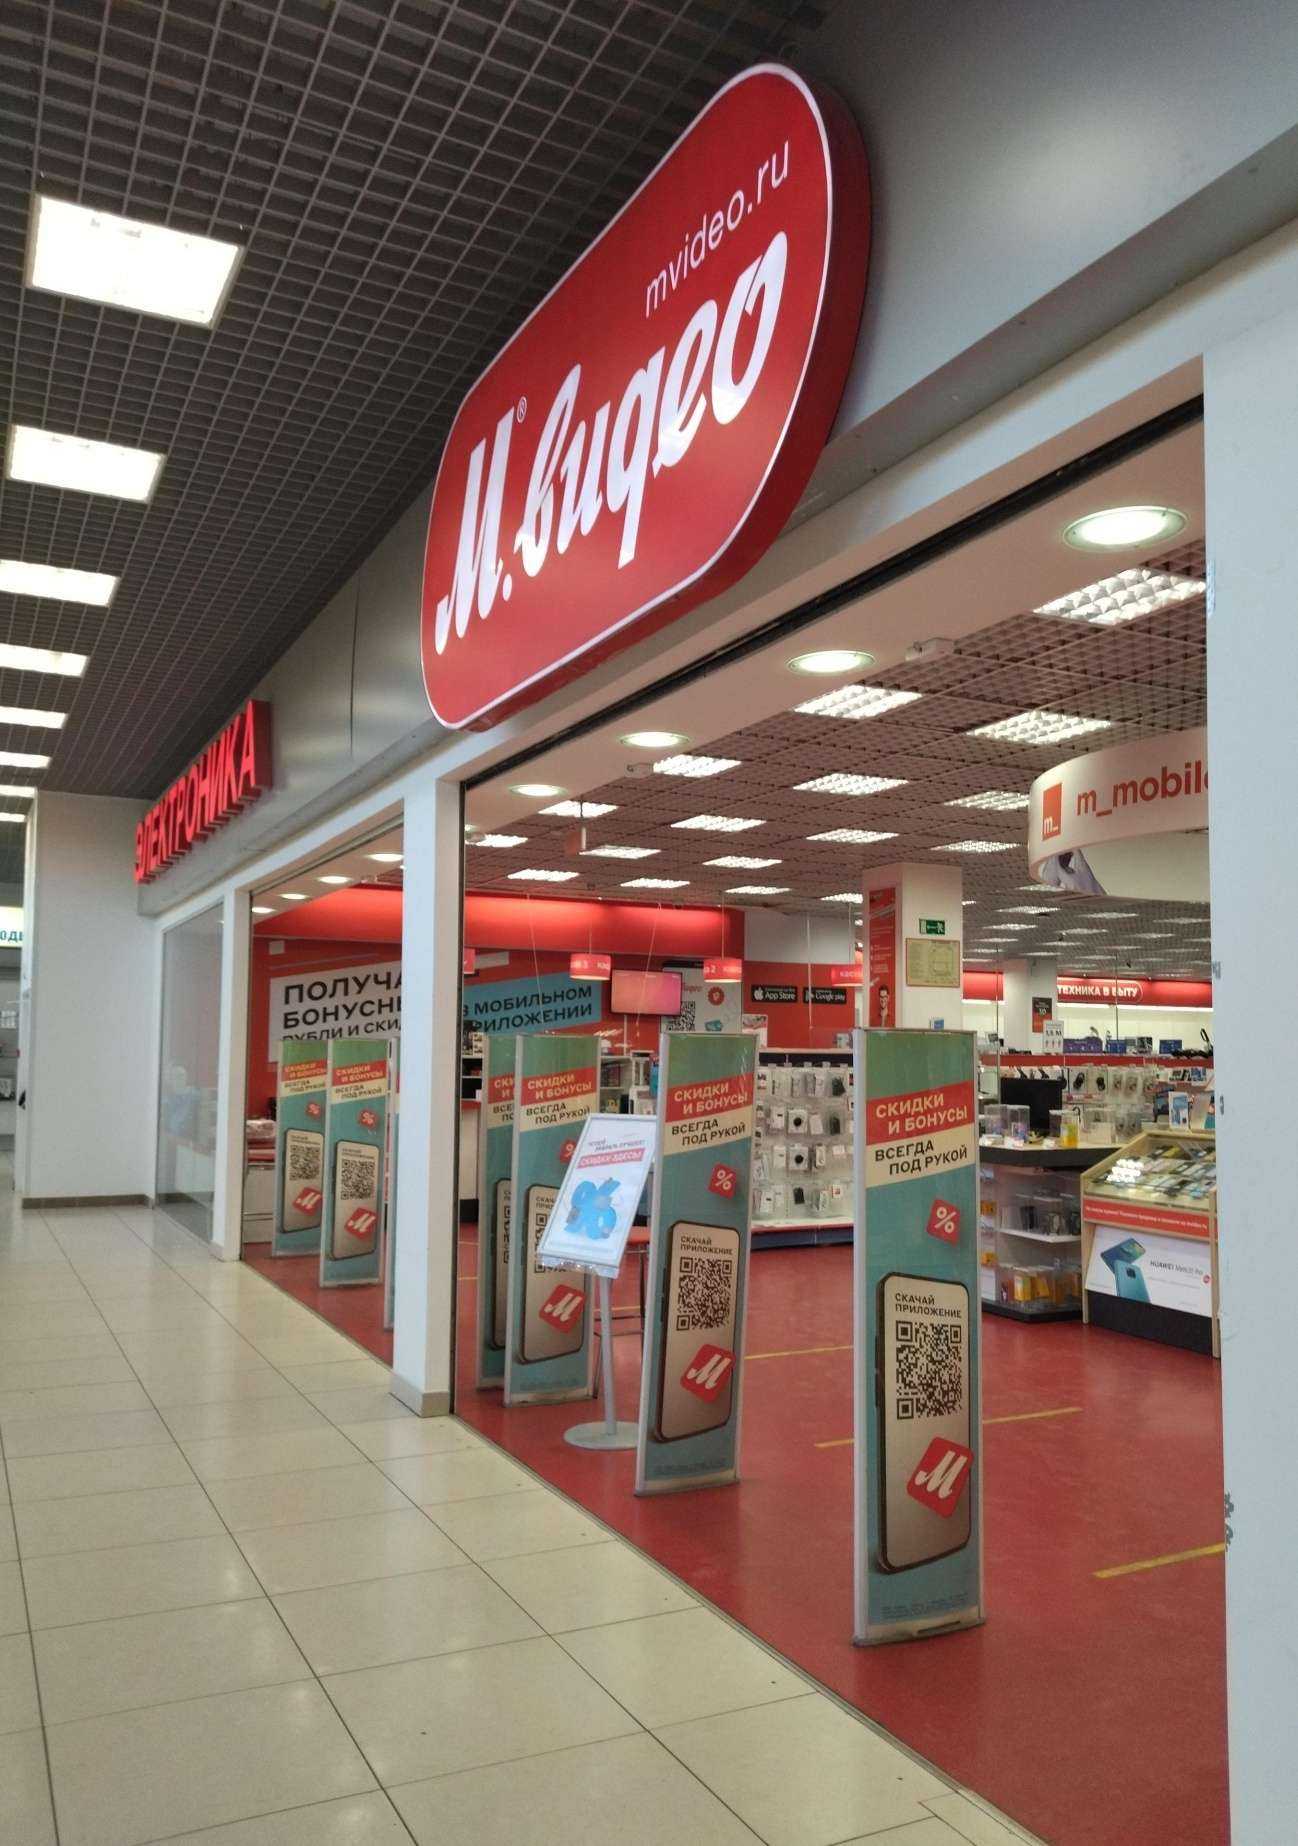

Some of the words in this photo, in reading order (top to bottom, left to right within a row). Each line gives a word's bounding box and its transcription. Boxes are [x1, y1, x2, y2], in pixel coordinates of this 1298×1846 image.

[645, 139, 789, 318] mvideo.ru
[134, 697, 256, 883] ЭЛЕКТРОНИКА
[474, 985, 592, 1014] МОБИЛЬНОМ
[765, 991, 779, 1000] App
[779, 991, 795, 1000] Store
[1057, 984, 1101, 996] ТЕХНИКА
[1103, 986, 1110, 996] В
[1112, 986, 1138, 998] БЫТУ
[472, 1003, 592, 1032] РИЛОЖЕНИИ
[348, 1024, 359, 1036] И
[364, 1018, 402, 1034] СКИ
[336, 1064, 371, 1077] СКИДКИ
[349, 1070, 383, 1082] БОНУСЫ
[528, 1074, 575, 1090] СКИДКИ
[535, 1091, 544, 1100] И
[546, 1081, 593, 1098] БОНУСЫ
[502, 1090, 510, 1098] И
[674, 1082, 729, 1102] СКИДКИ
[526, 1102, 566, 1117] ВСЕГДА
[683, 1104, 692, 1115] И
[696, 1091, 748, 1112] БОНУСЫ
[876, 1093, 945, 1119] СКИДКИ
[535, 1115, 557, 1125] ПОД
[559, 1105, 590, 1120] РУКОЙ
[888, 1121, 900, 1136] И
[905, 1105, 968, 1132] БОНУСЫ
[671, 1118, 719, 1135] ВСЕГДА
[682, 1133, 708, 1146] ПОД
[710, 1121, 746, 1140] РУКОЙ
[875, 1139, 934, 1162] ВСЕГДА
[889, 1160, 921, 1176] ПОД
[924, 1145, 968, 1169] РУКОЙ
[680, 1235, 712, 1245] СКАЧАЙ
[680, 1244, 733, 1256] ПРИЛОЖЕНИЕ
[894, 1293, 935, 1306] СКАЧАЙ
[894, 1304, 962, 1319] ПРИЛОЖЕНИЕ
